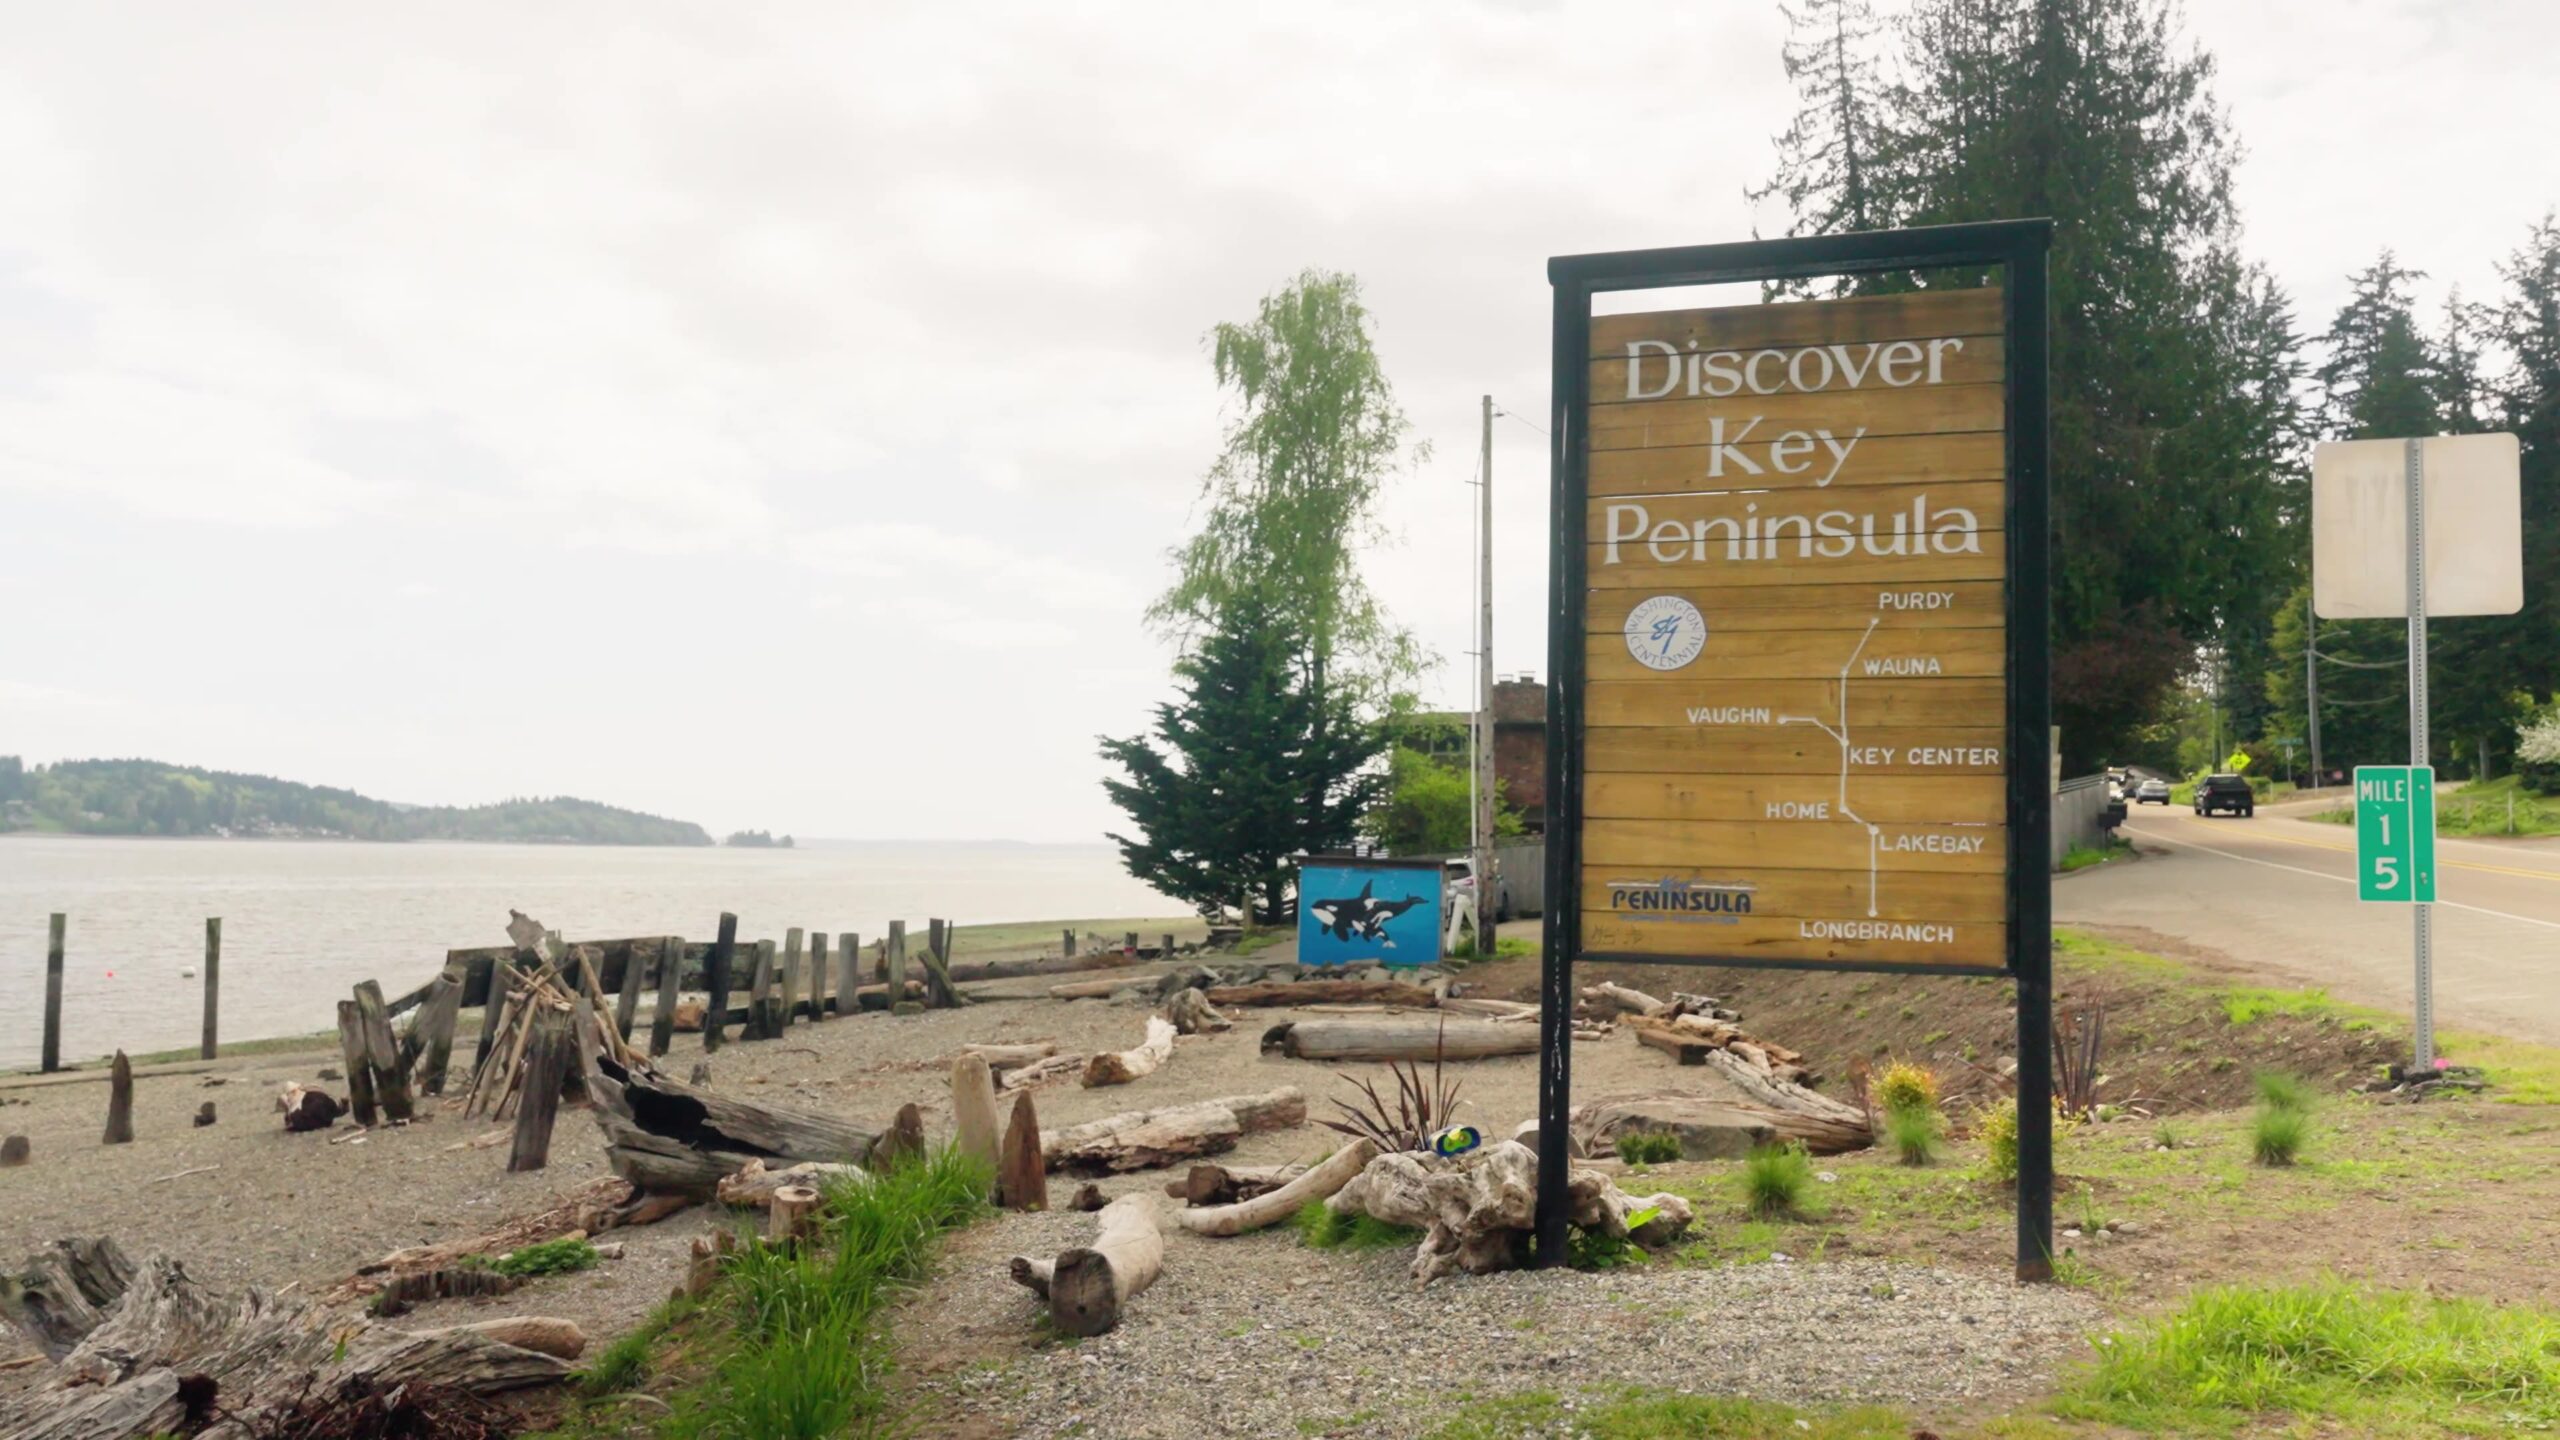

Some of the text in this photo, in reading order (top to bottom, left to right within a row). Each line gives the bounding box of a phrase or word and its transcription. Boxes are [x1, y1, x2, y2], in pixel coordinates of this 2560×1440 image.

[1626, 339, 1963, 399] Discover
[1707, 415, 1866, 487] Key
[1603, 494, 1982, 564] Peninsula
[1879, 592, 1954, 609] PURDY
[1627, 598, 1701, 632] WASHINGTON
[1630, 634, 1703, 667] CENTENNIAL
[1864, 659, 1941, 675] WAUNA
[1687, 707, 1770, 724] VAUGHN
[1850, 748, 1999, 766] KEY CENTER
[2360, 780, 2405, 801] MILE
[1766, 803, 1829, 819] HOME
[1879, 836, 1985, 854] LAKEBAY
[1612, 890, 1752, 913] PENINSULA
[1800, 922, 1954, 942] LONGBRANCH
